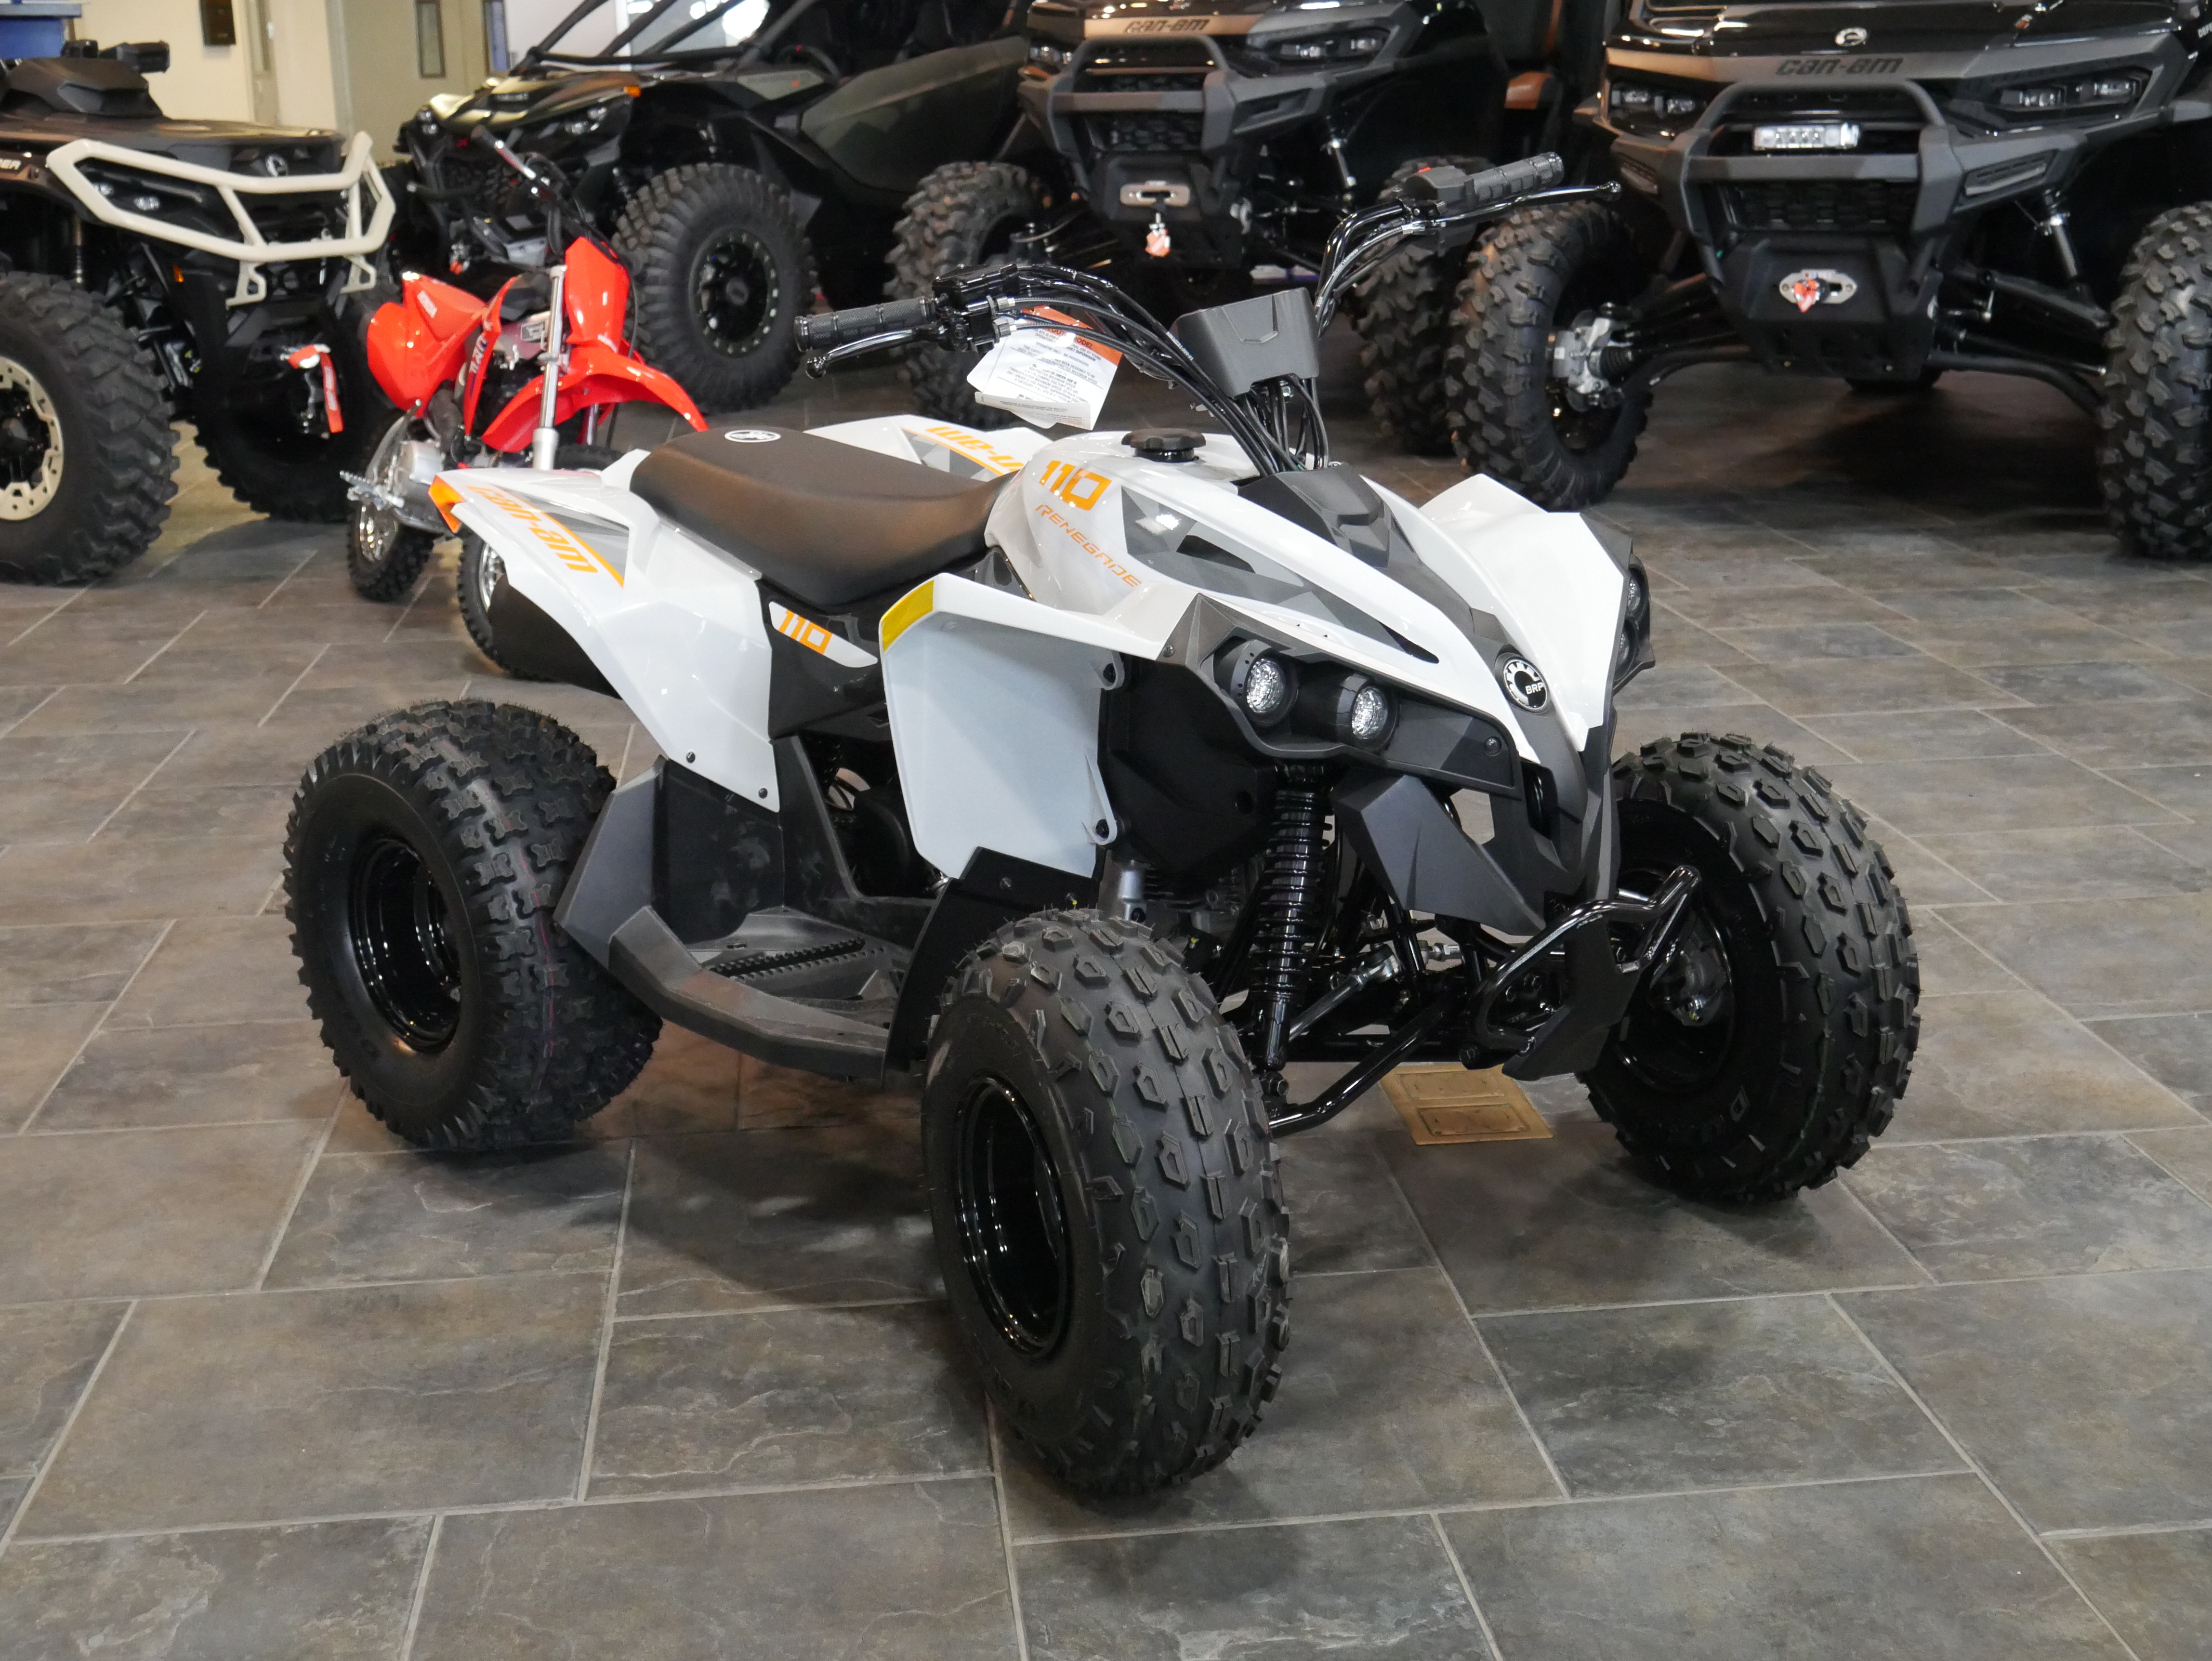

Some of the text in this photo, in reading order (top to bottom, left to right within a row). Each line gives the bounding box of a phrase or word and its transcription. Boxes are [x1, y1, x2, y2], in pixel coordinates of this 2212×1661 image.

[1776, 57, 1903, 75] can-am
[1073, 335, 1093, 348] ODEL
[1039, 460, 1112, 511] 110
[465, 485, 598, 573] can-am
[1035, 504, 1142, 588] RENEGADE
[777, 609, 834, 655] 110
[1525, 682, 1543, 695] BRP
